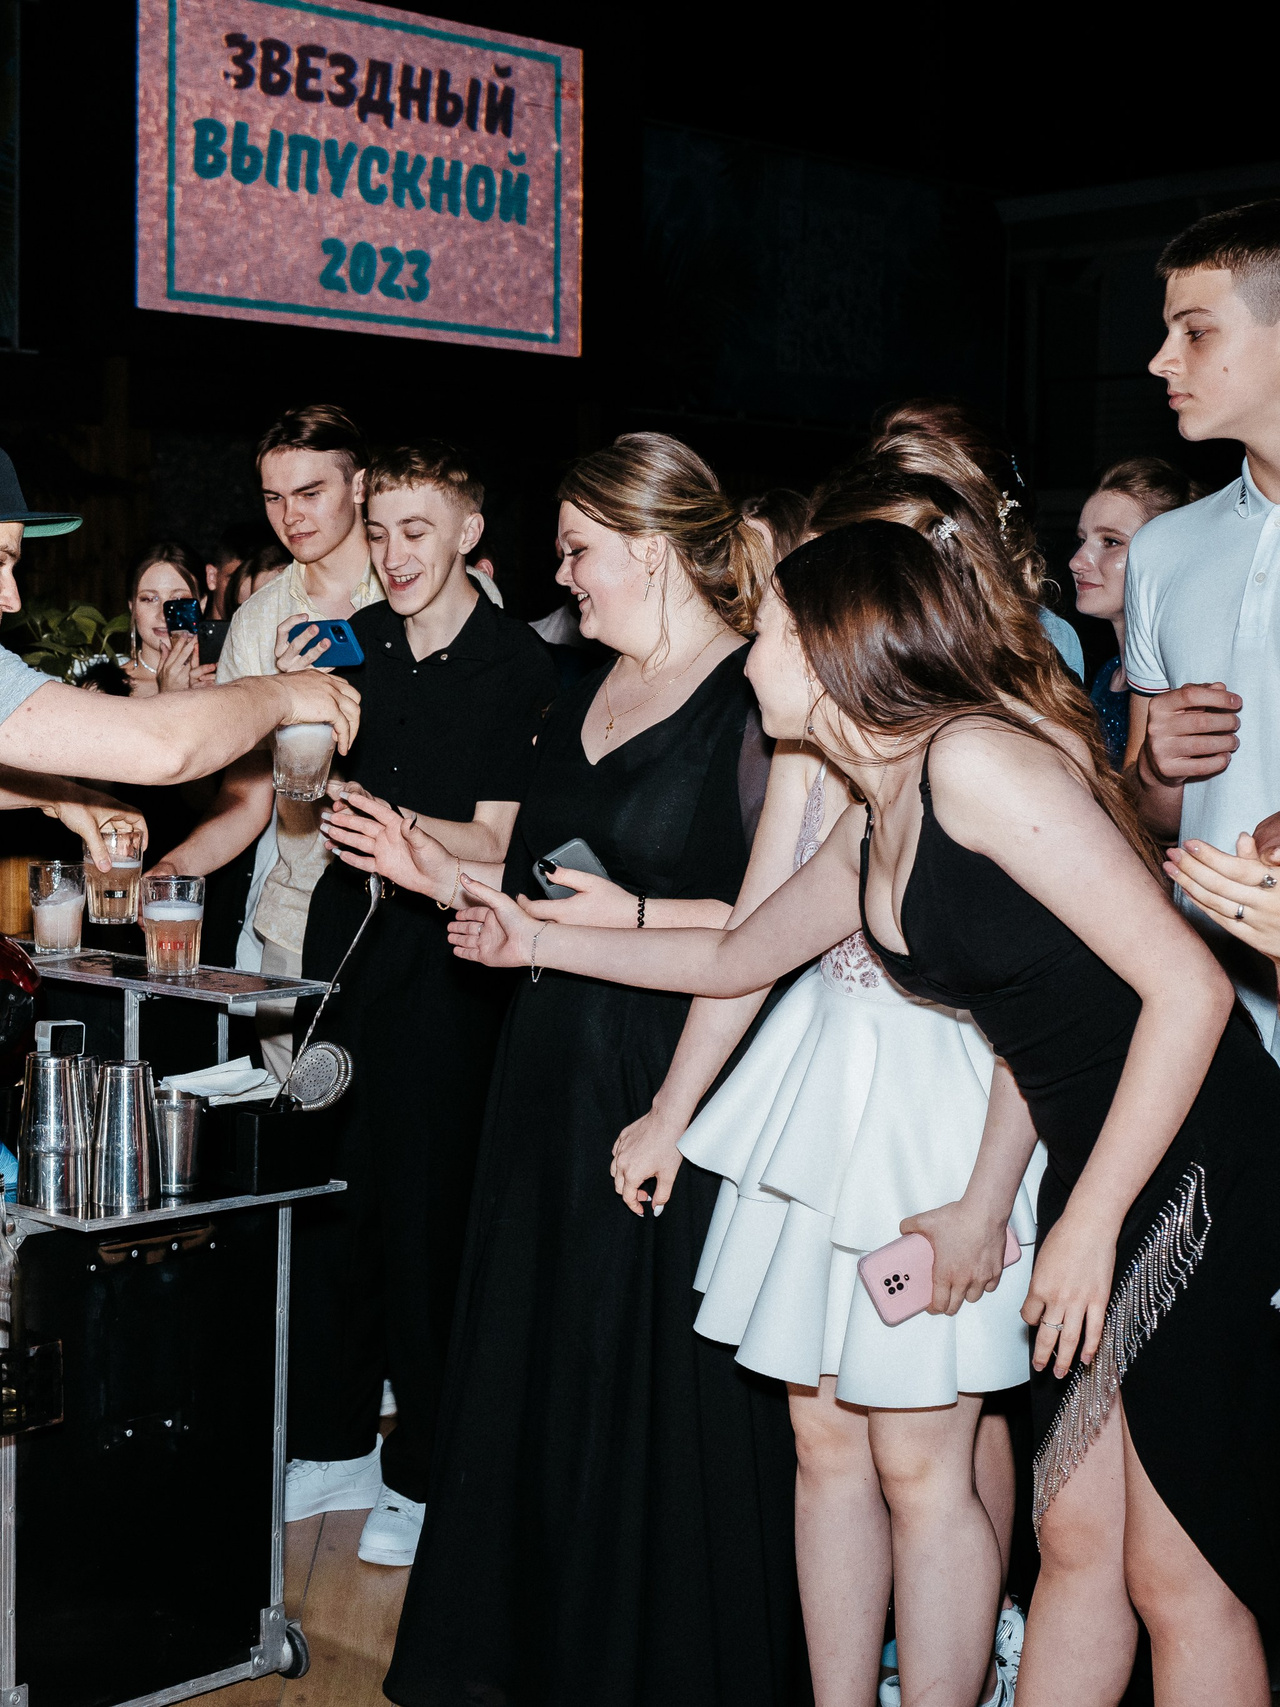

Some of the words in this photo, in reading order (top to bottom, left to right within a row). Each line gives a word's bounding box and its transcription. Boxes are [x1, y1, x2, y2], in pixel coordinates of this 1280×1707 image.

[224, 32, 515, 139] ЗВЕЗДНЫЙ
[192, 117, 531, 226] ВЫПУСКНОЙ
[319, 237, 432, 303] 2023
